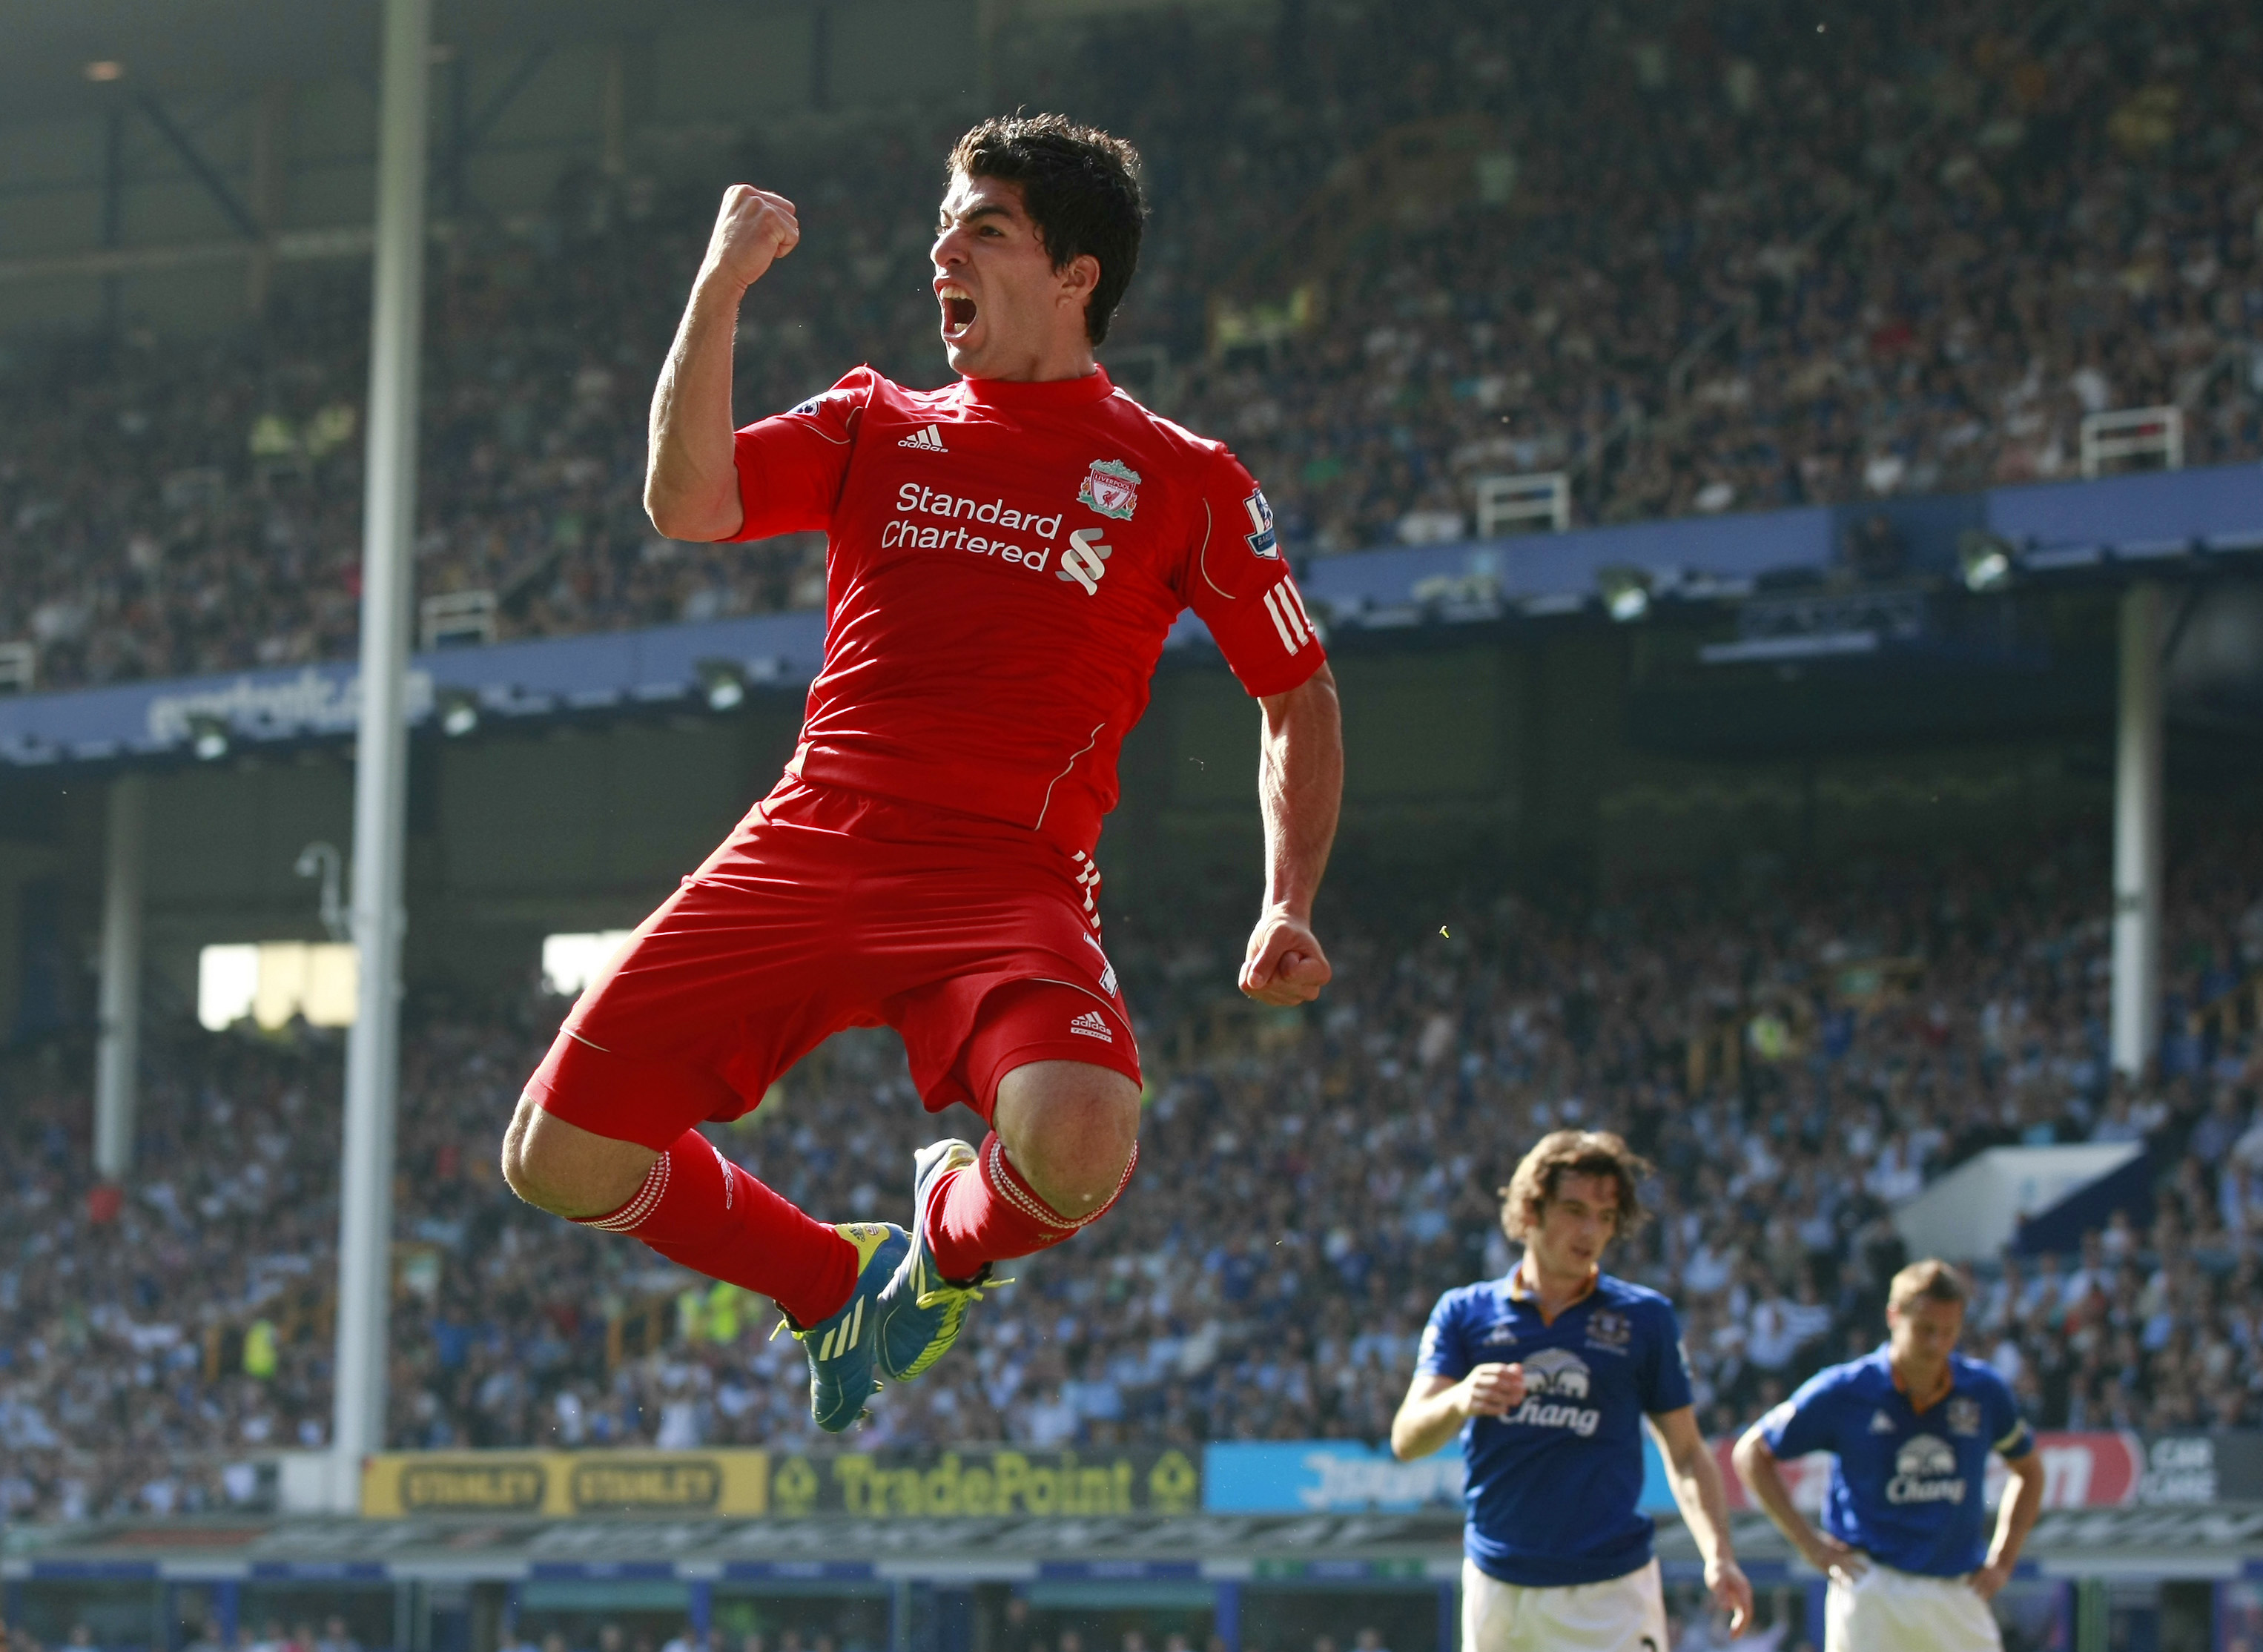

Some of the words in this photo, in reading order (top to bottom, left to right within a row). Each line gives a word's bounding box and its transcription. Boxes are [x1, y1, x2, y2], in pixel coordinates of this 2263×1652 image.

[897, 440, 949, 453] adidas
[1094, 474, 1131, 491] LIVERPOOL
[896, 483, 1063, 540] Standard
[882, 520, 1050, 572] Chartered
[1071, 1019, 1112, 1035] adidas
[833, 1451, 1133, 1517] TradePoint
[1885, 1475, 1966, 1505] Chang
